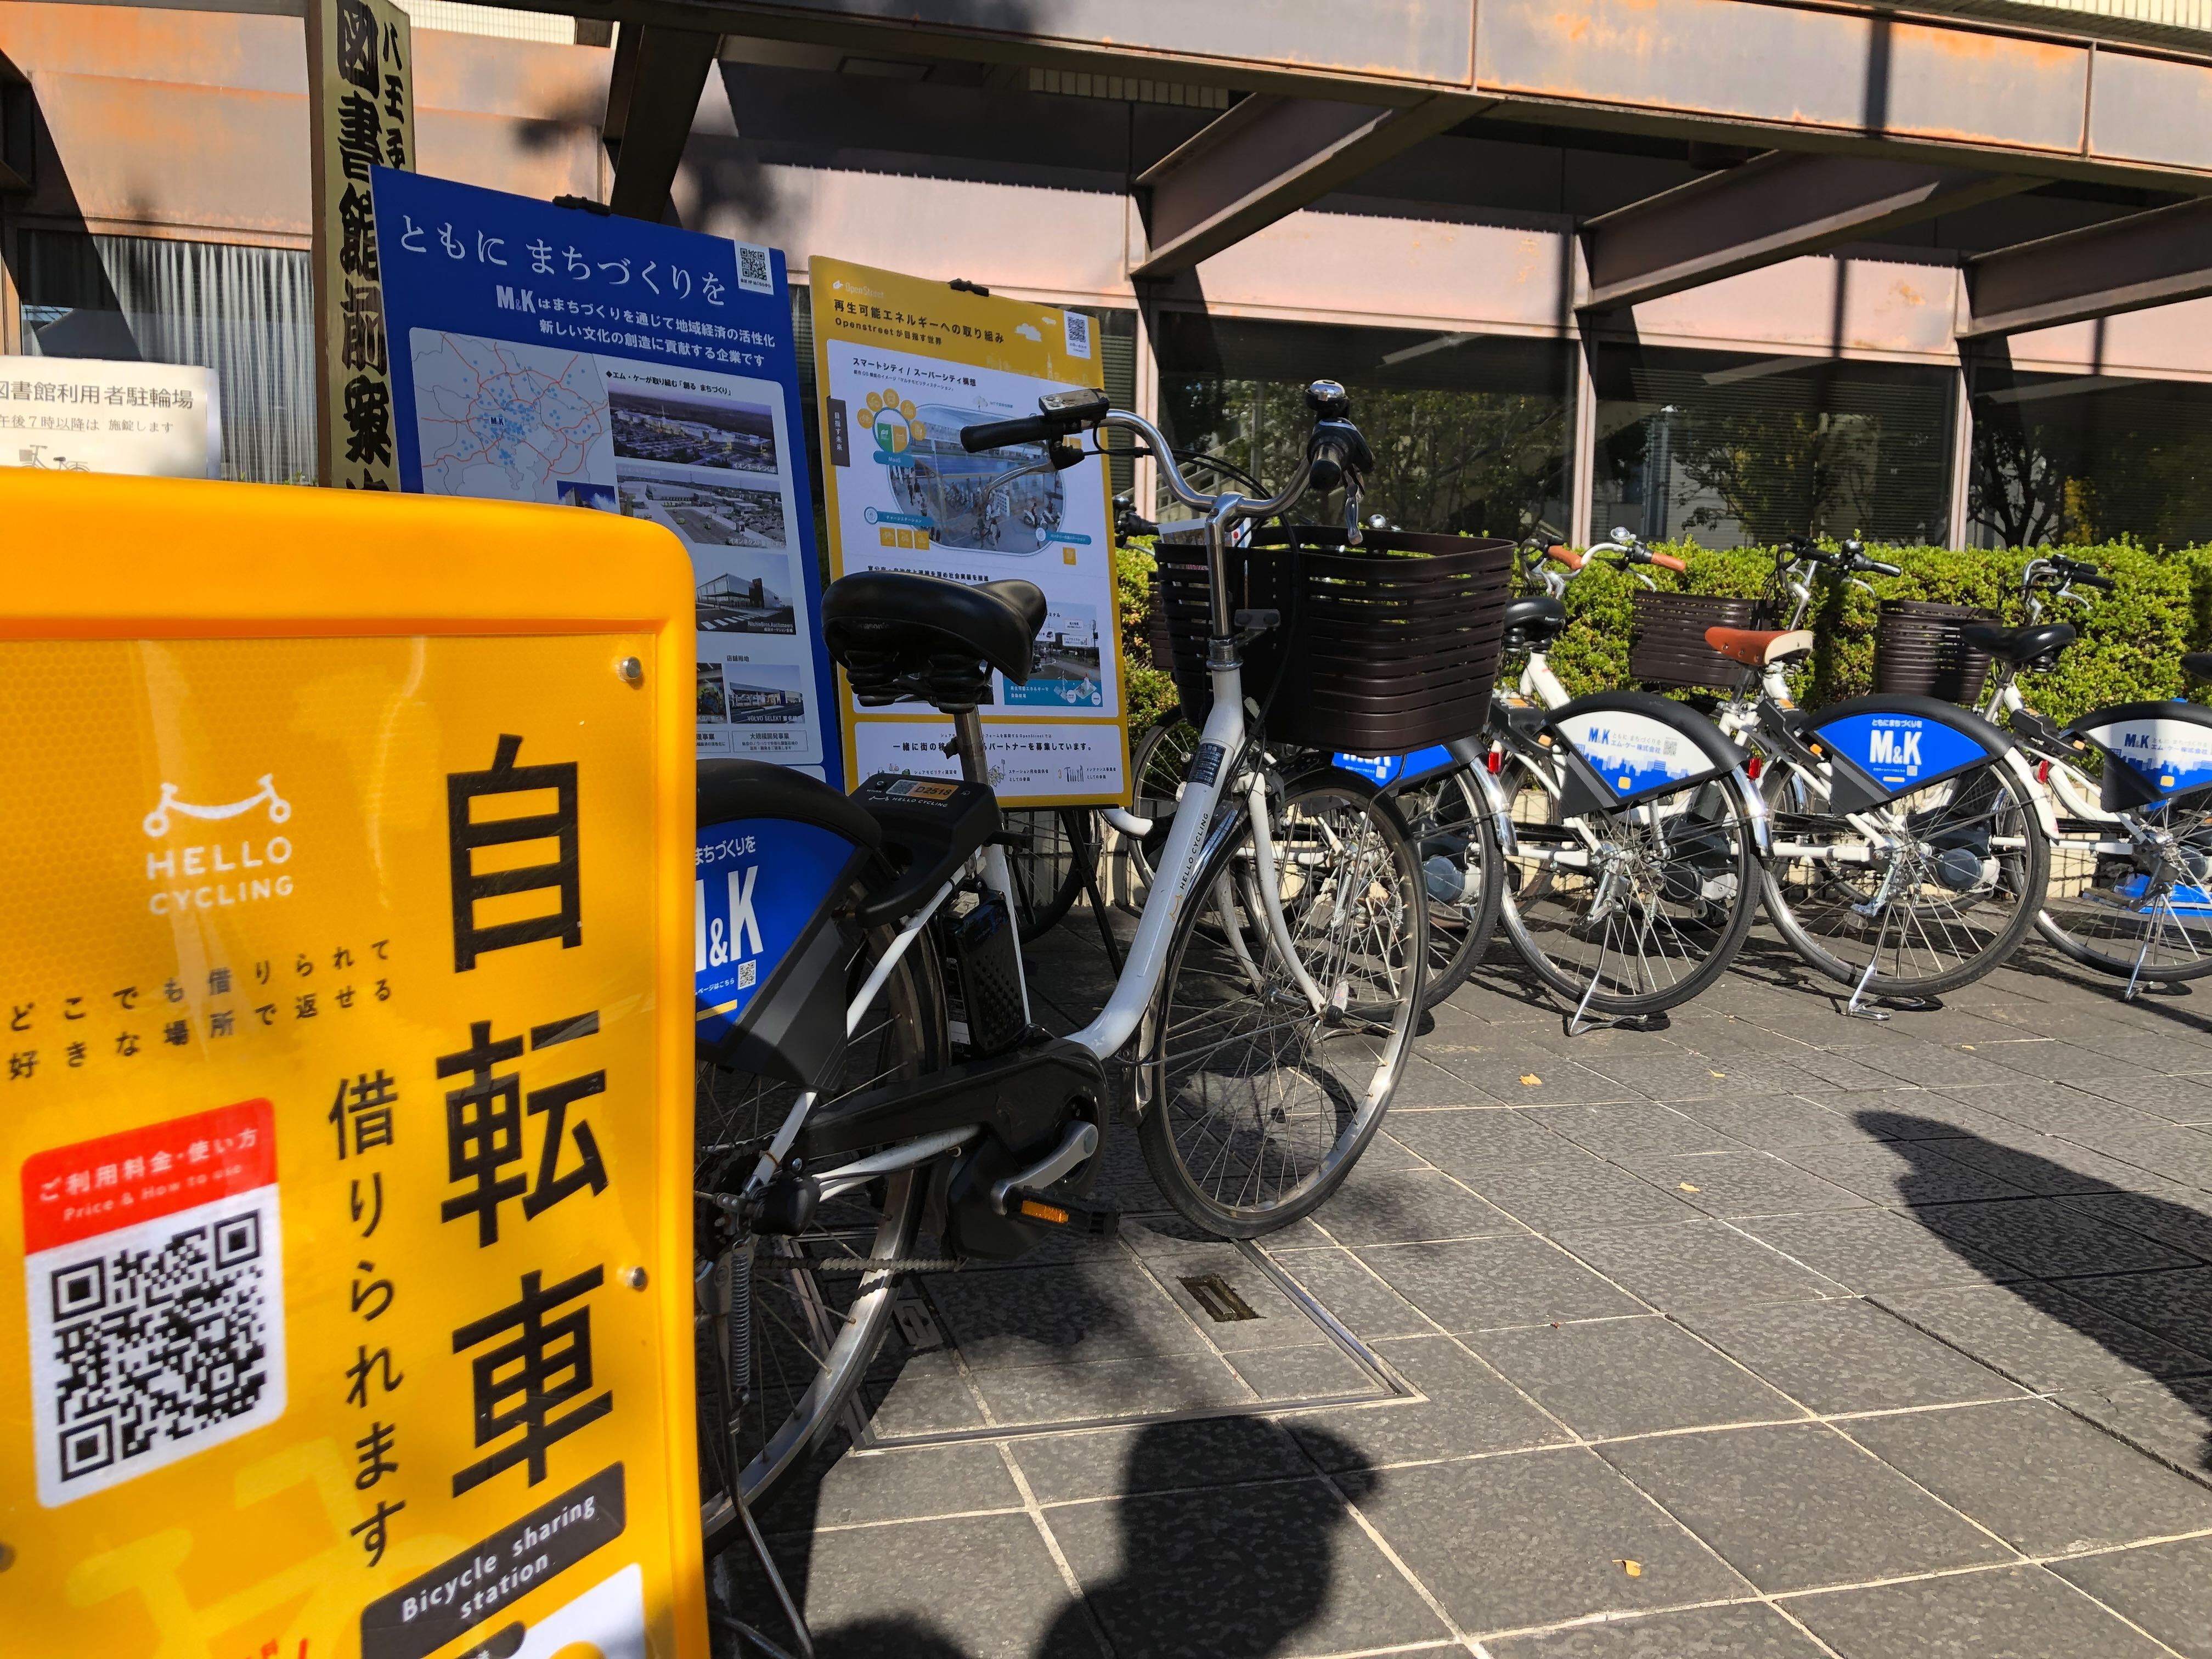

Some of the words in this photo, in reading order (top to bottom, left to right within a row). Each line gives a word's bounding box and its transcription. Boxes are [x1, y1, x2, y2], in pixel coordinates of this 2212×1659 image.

[401, 215, 507, 266] ともに
[526, 238, 725, 306] まちづくりを
[496, 285, 536, 314] M&K
[538, 298, 775, 348] はまちづくりを通じて地域経済の活性化
[834, 299, 1004, 344] 再生可能エネルギーへの取り組み
[539, 319, 765, 367] 新しい文化の創造に貢献する企業です
[853, 358, 903, 374] スマートシティ
[1589, 727, 1610, 745] M&K
[1870, 730, 1922, 765] M&K
[2124, 733, 2149, 749] M&K
[915, 786, 952, 795] D2518
[918, 799, 948, 808] CYCLING
[146, 836, 292, 879] HELLO
[1180, 857, 1194, 890] HELLO
[1192, 812, 1209, 854] CYCLING
[149, 874, 294, 916] CYCLING
[10, 939, 391, 1031] どこでも借りられて
[8, 979, 391, 1080] 好きな場所で返せる
[436, 733, 613, 1498] 自転車
[40, 1127, 258, 1201] ご利用料金・使い方
[64, 1197, 114, 1222] Price
[121, 1192, 134, 1206] &
[141, 1181, 180, 1200] How
[187, 1173, 207, 1188] to
[328, 1069, 406, 1568] 借りられます
[402, 1554, 496, 1623] Bicycle
[512, 1496, 595, 1556] sharing
[460, 1554, 548, 1620] station
